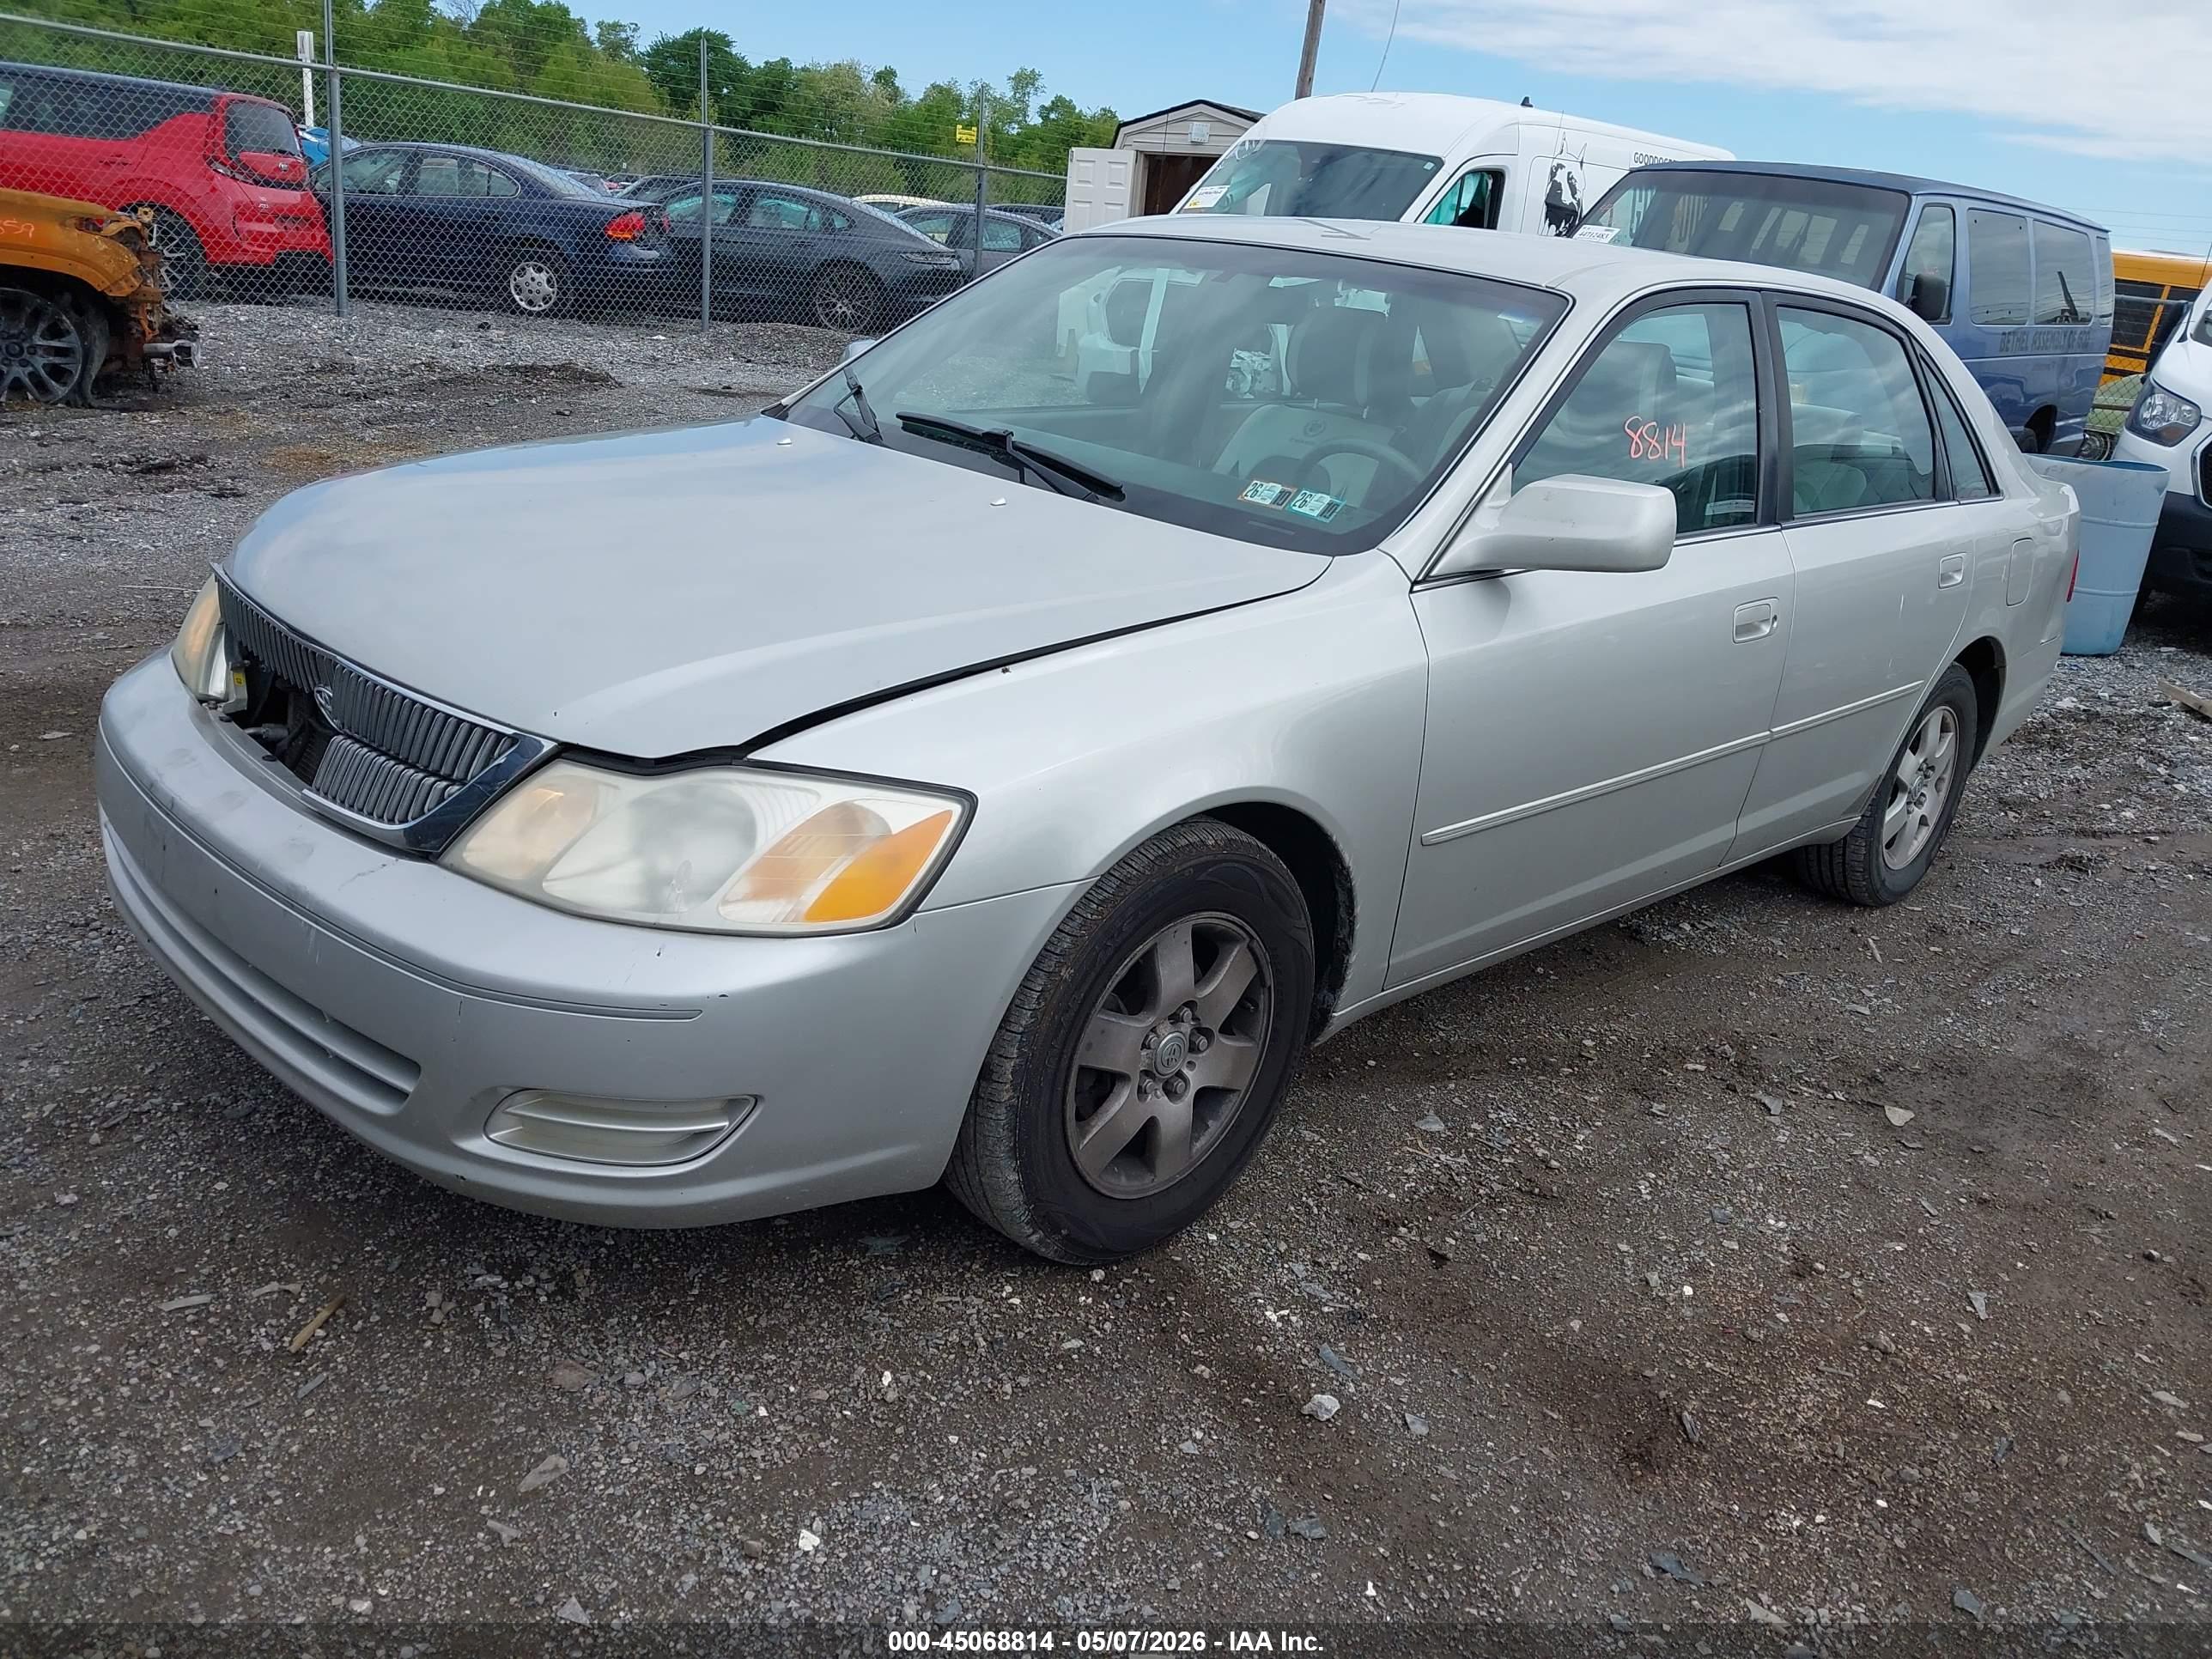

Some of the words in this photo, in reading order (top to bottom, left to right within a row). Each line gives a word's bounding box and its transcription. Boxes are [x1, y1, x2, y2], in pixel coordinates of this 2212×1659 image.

[1999, 331, 2028, 352] BETHEL
[1625, 416, 1686, 469] 8814
[1244, 482, 1264, 499] 26
[1292, 492, 1313, 509] 26
